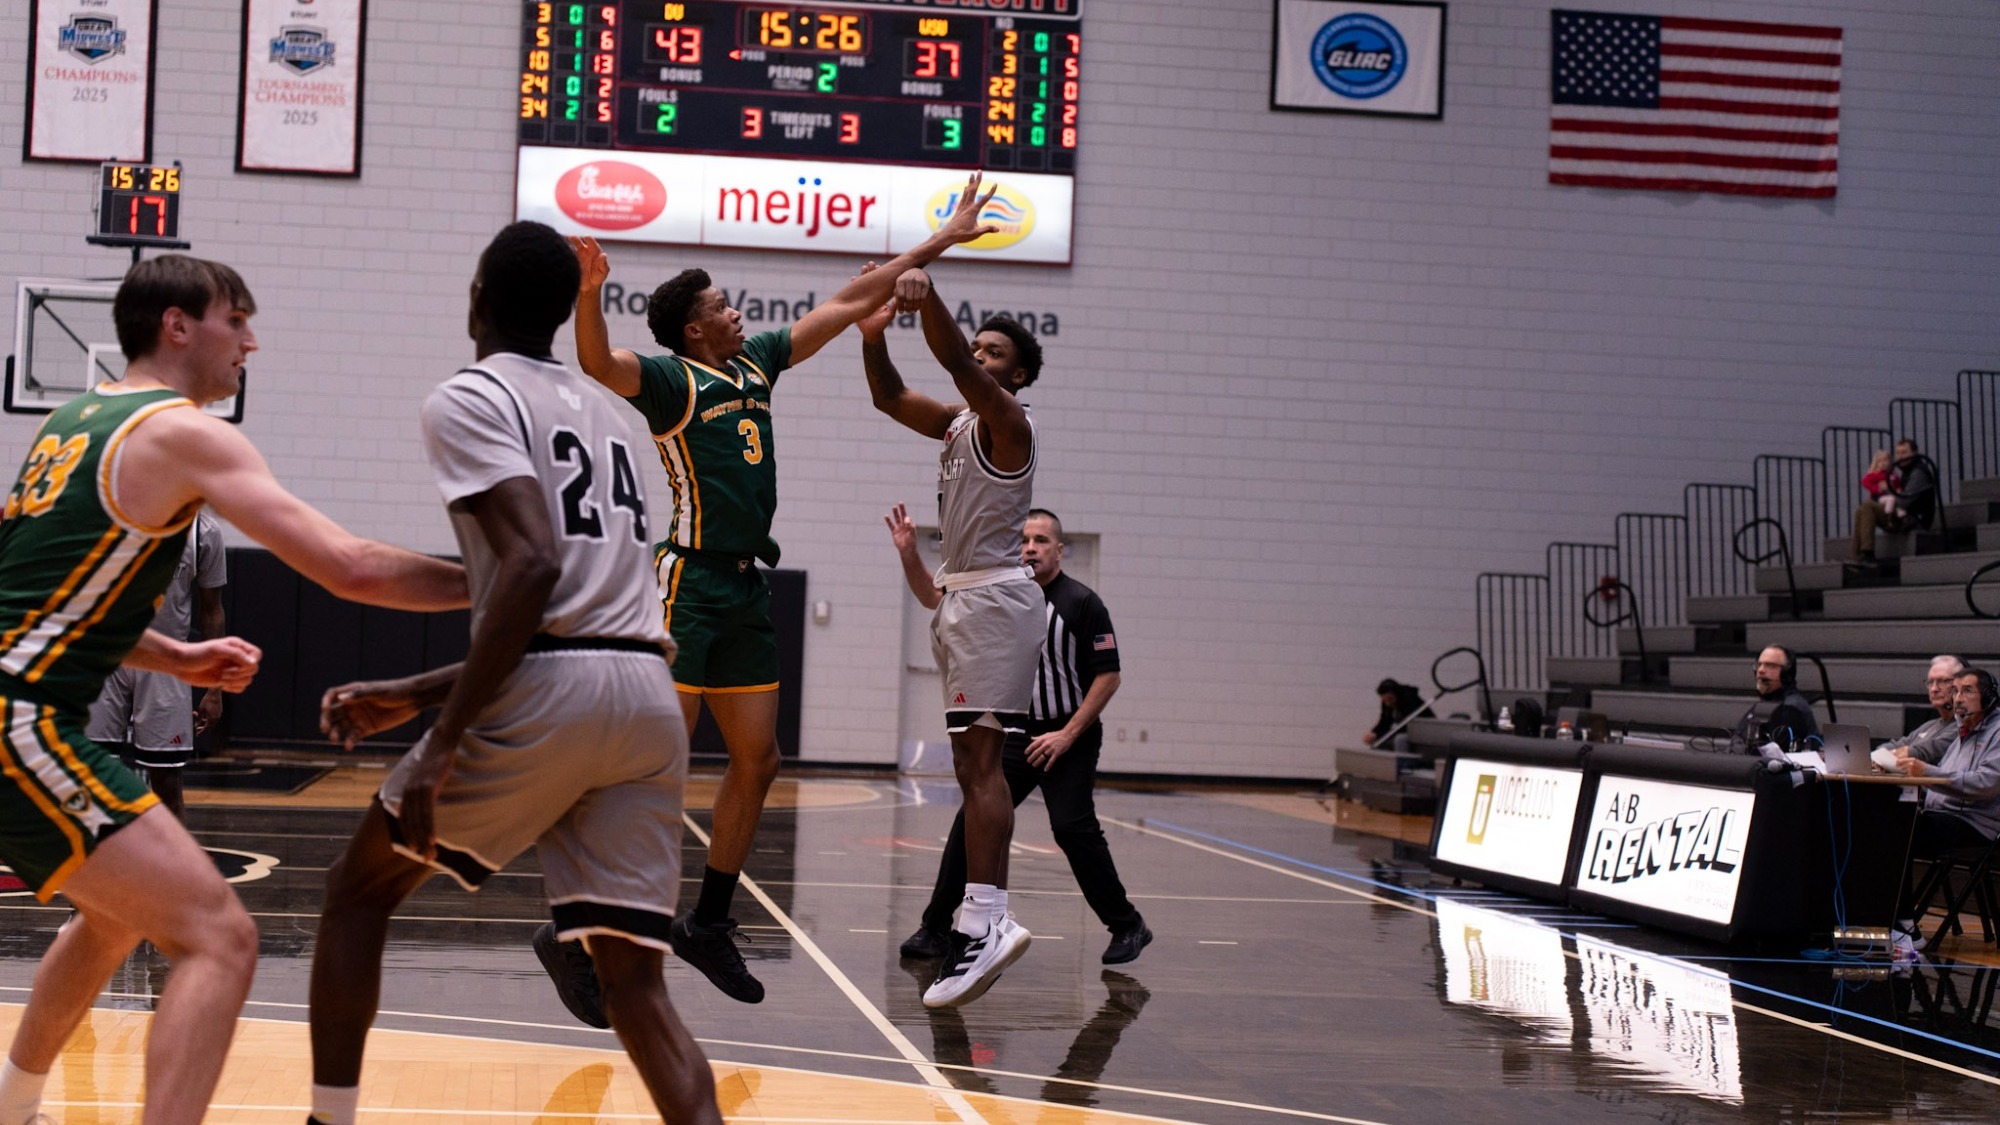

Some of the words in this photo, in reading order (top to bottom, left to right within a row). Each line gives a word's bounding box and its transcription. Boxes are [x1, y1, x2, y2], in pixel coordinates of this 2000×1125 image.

[537, 3, 551, 23] 3
[569, 4, 584, 25] 0
[601, 6, 616, 26] 9
[536, 26, 550, 47] 5
[575, 29, 582, 48] 1
[600, 30, 614, 50] 6
[760, 11, 862, 50] 15:26
[1003, 30, 1018, 50] 2
[1034, 32, 1048, 52] 0
[1066, 34, 1079, 53] 7
[655, 27, 701, 63] 43
[529, 50, 550, 71] 10
[574, 52, 581, 72] 1
[593, 54, 613, 73] 13
[915, 41, 961, 77] 37
[1002, 54, 1017, 74] 3
[1039, 56, 1047, 75] 1
[1065, 57, 1078, 77] 5
[1327, 50, 1392, 71] GLIAC
[44, 66, 138, 84] CHAMPIONS
[257, 78, 346, 94] TOURNAMENT
[521, 73, 549, 94] 24
[566, 76, 580, 97] 0
[598, 78, 613, 98] 2
[660, 67, 702, 83] BONUS
[767, 65, 814, 81] PERIOD
[817, 63, 838, 92] 2
[72, 87, 108, 102] 2025
[255, 91, 347, 108] CHAMPIONS
[638, 88, 678, 103] FOULS
[901, 82, 943, 97] BONUS
[989, 77, 1016, 98] 22
[1038, 80, 1047, 99] 1
[1063, 81, 1078, 101] 0
[282, 109, 319, 126] 2025
[521, 98, 548, 119] 34
[565, 101, 579, 121] 2
[598, 103, 612, 123] 5
[656, 104, 676, 133] 2
[923, 104, 963, 119] FOULS
[988, 100, 1015, 121] 24
[1031, 102, 1046, 123] 2
[1063, 104, 1077, 125] 2
[742, 107, 763, 138] 3
[770, 110, 832, 127] TIMEOUTS
[839, 113, 860, 143] 3
[784, 126, 814, 139] LEFT
[942, 119, 961, 148] 3
[987, 125, 1014, 144] 44
[1031, 126, 1045, 147] 0
[1062, 128, 1076, 148] 8
[129, 195, 166, 237] 17
[717, 176, 877, 239] meijer
[700, 398, 743, 424] WAYNE
[737, 418, 763, 465] 3
[4, 432, 91, 519] 33
[547, 424, 648, 548] 24
[1587, 806, 1741, 885] RENTAL
